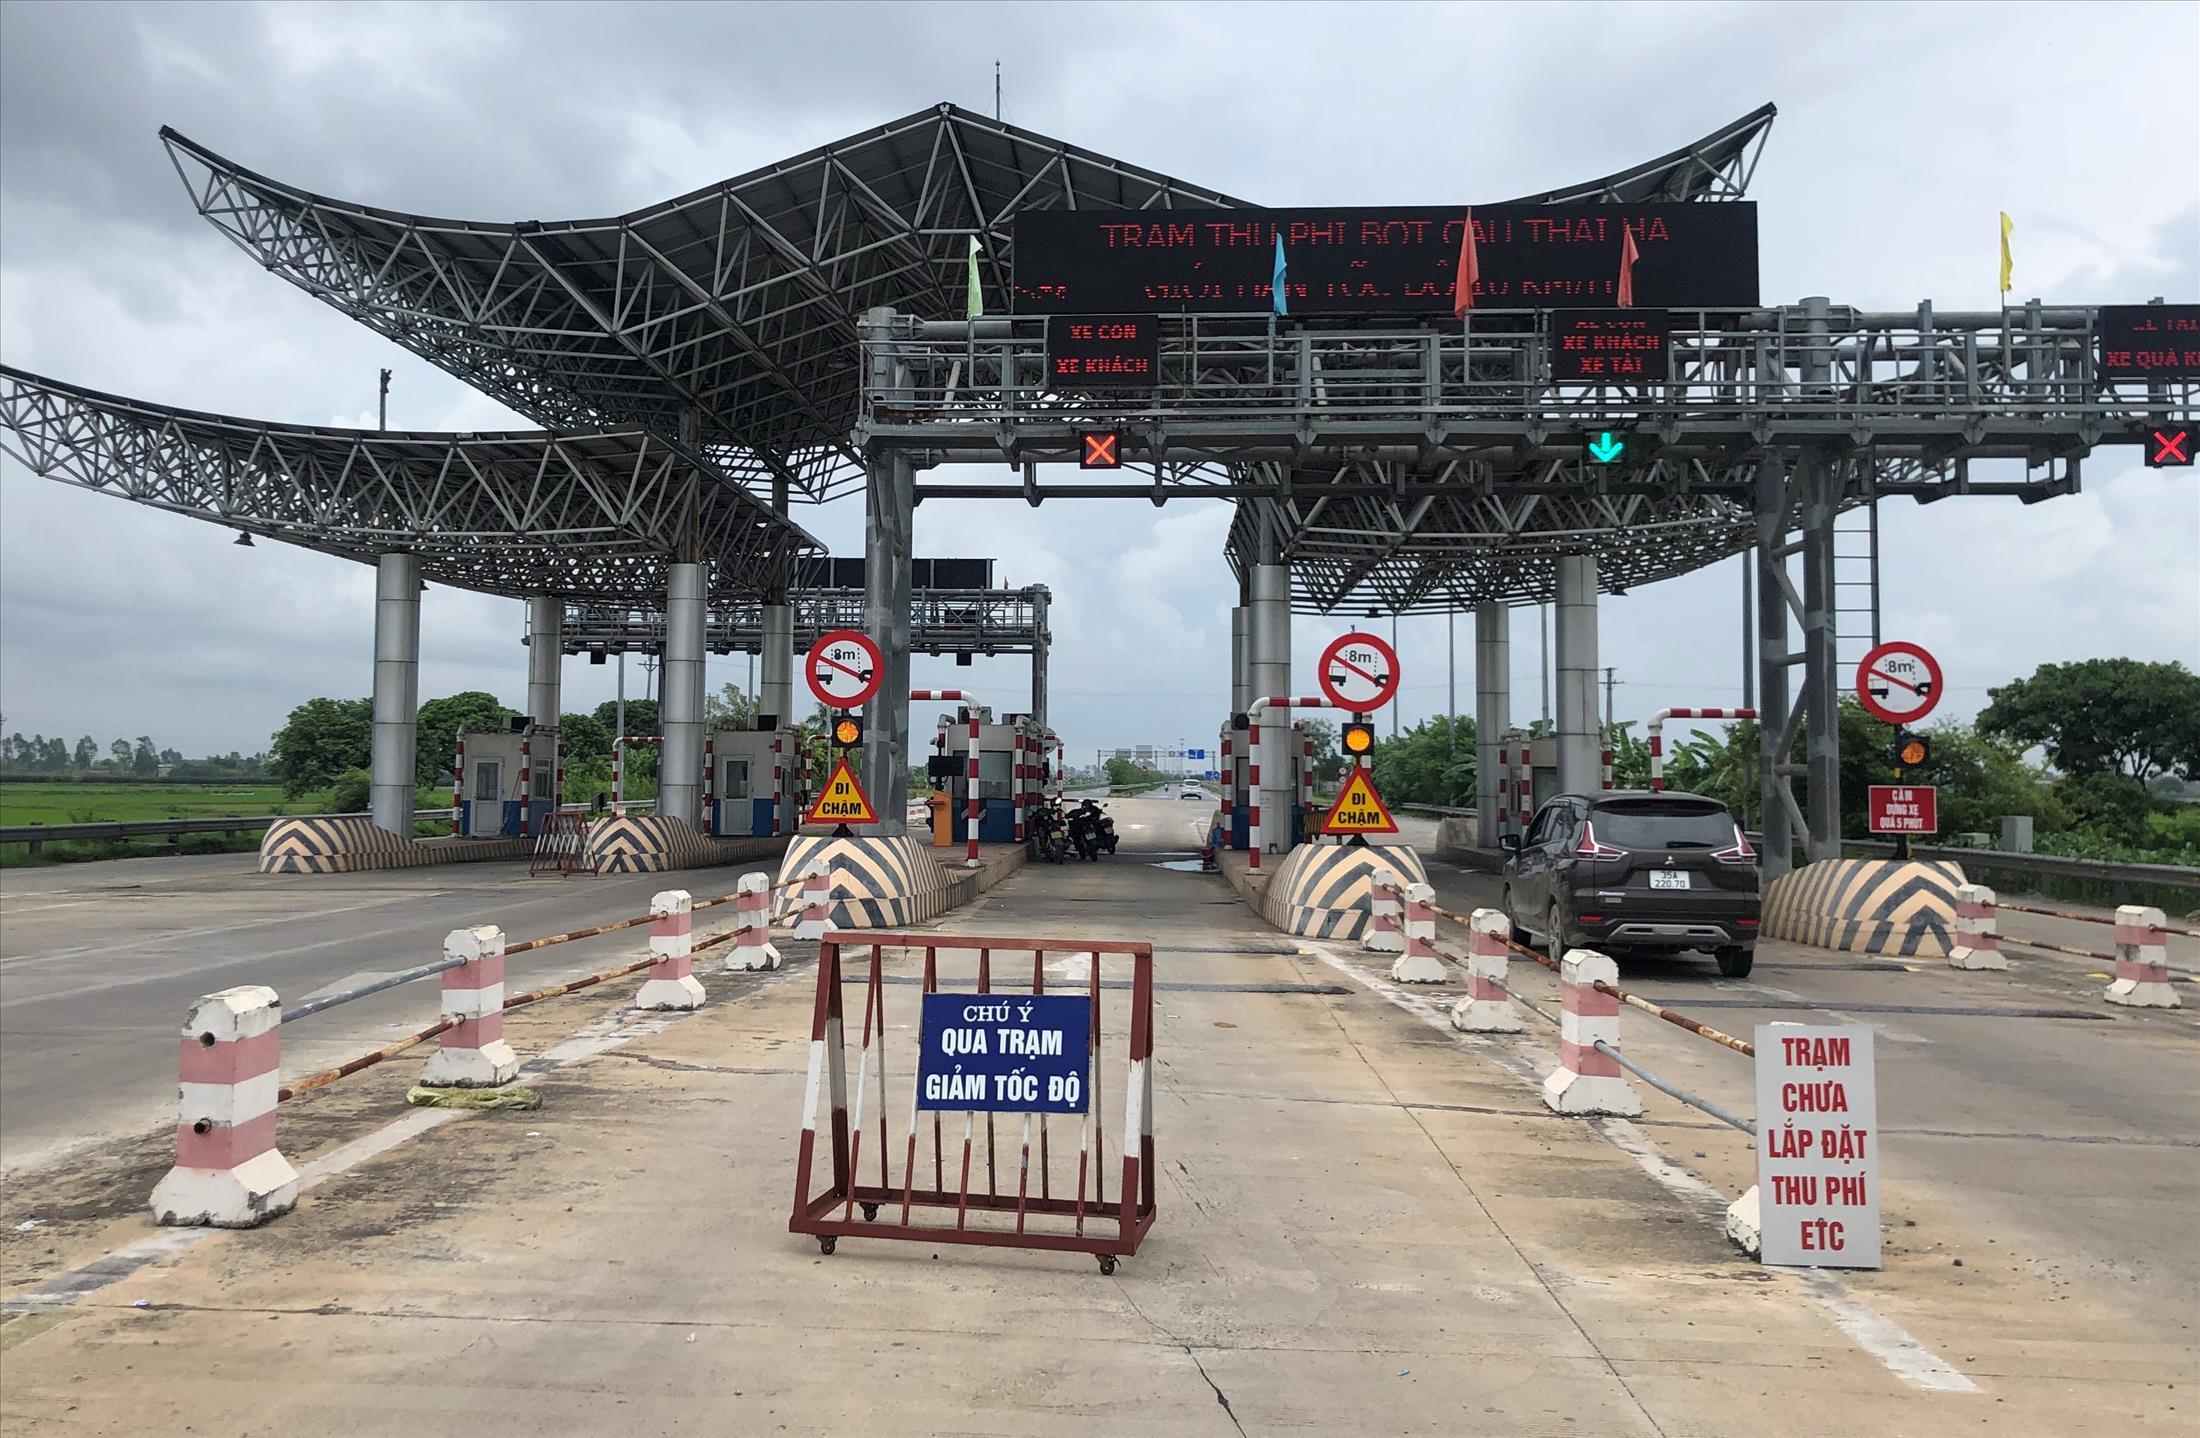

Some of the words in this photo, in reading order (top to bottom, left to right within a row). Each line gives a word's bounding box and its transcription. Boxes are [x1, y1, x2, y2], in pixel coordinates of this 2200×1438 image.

[1070, 324, 1093, 339] XE
[1098, 324, 1137, 339] CON
[1056, 358, 1080, 373] XE
[1085, 355, 1149, 373] KHÁCH
[833, 648, 856, 661] 8m
[1349, 650, 1372, 664] 8m
[1888, 660, 1912, 673] 8m
[835, 782, 850, 795] ĐI
[1351, 793, 1366, 805] ĐI
[822, 800, 862, 817] CHẬM
[1337, 808, 1380, 826] CHẬM
[963, 1000, 1010, 1022] CHÚ
[1017, 1001, 1034, 1022] Ý
[941, 1028, 988, 1056] QUA
[997, 1029, 1063, 1060] TRẠM
[1782, 1037, 1851, 1071] TRẠM
[926, 1064, 986, 1100] GIẢM
[994, 1067, 1038, 1101] TỐC
[1048, 1071, 1081, 1108] ĐỘ
[1782, 1080, 1848, 1112] CHƯA
[1768, 1118, 1813, 1158] LẮP
[1821, 1124, 1867, 1164] ĐẶT
[1771, 1176, 1816, 1205] THU
[1825, 1171, 1867, 1206] PHÍ
[1801, 1220, 1845, 1251] ETC
